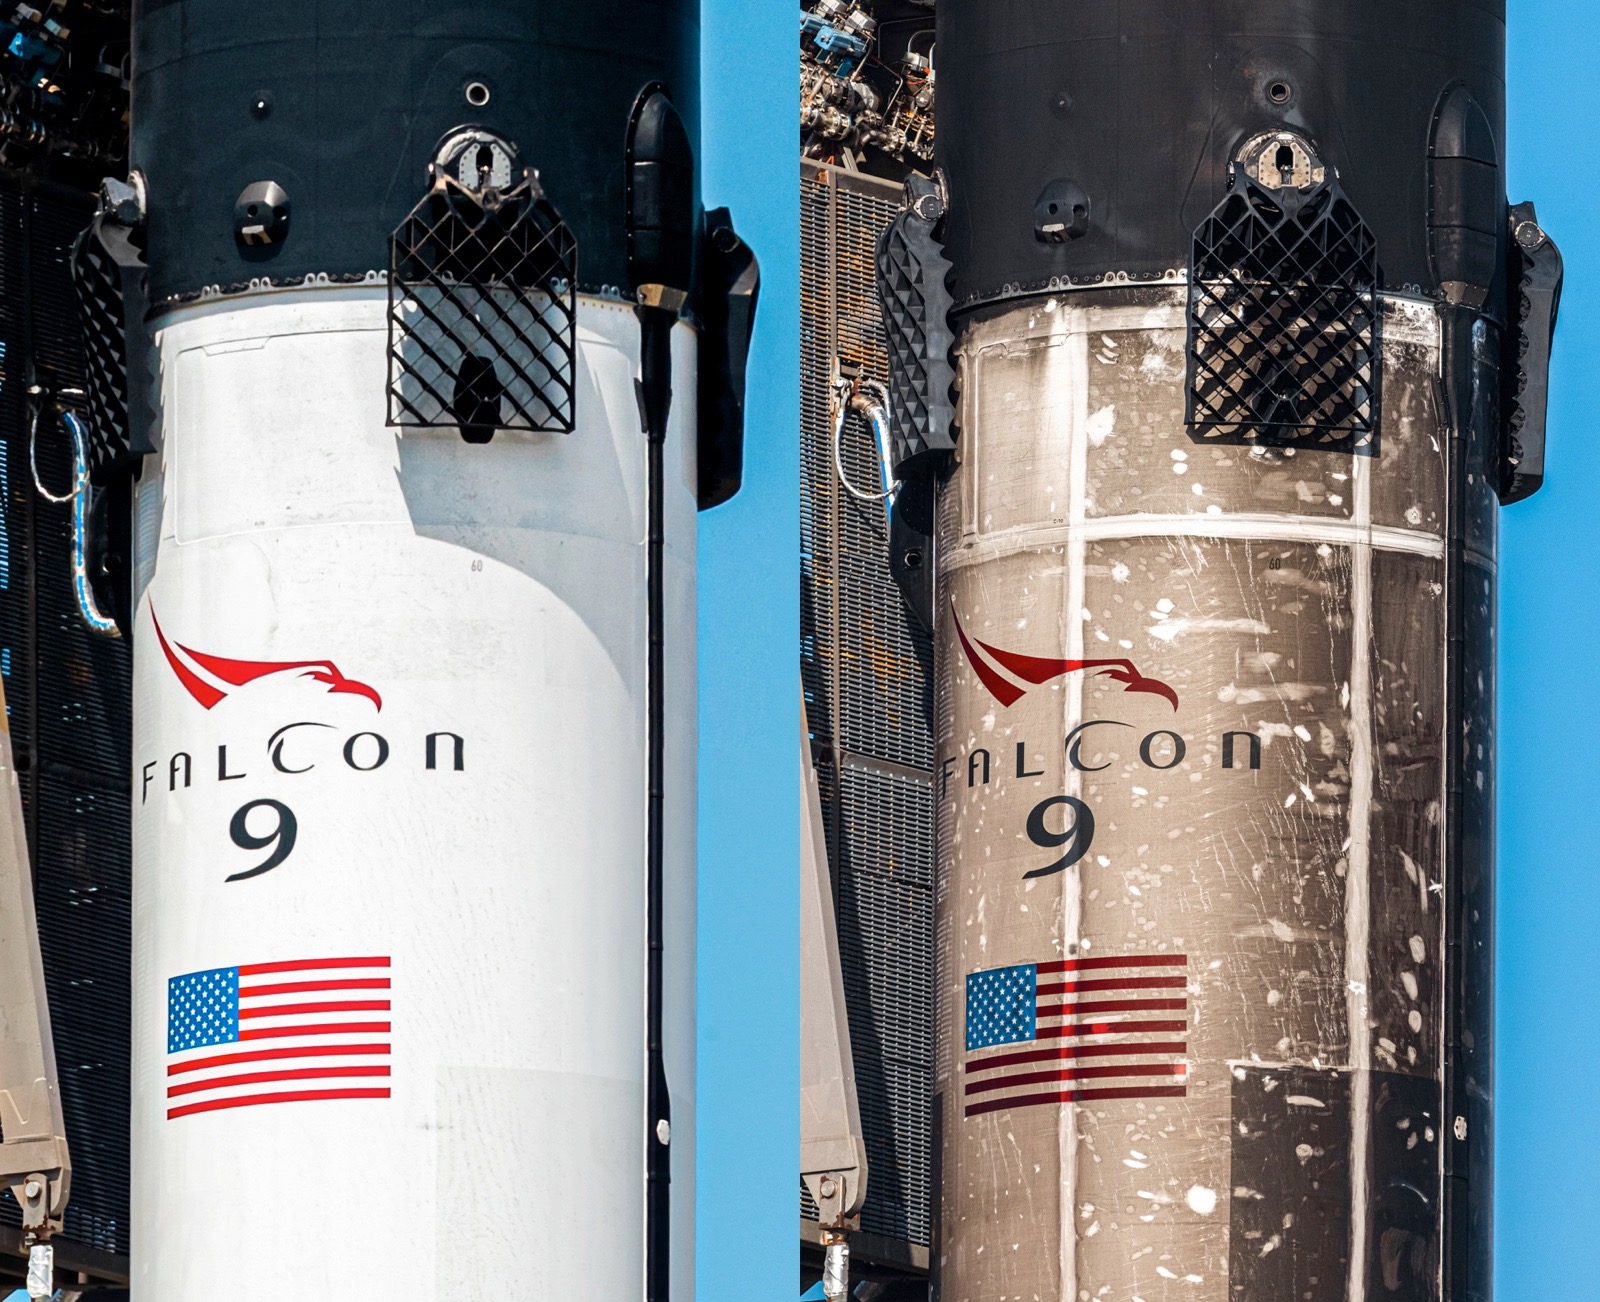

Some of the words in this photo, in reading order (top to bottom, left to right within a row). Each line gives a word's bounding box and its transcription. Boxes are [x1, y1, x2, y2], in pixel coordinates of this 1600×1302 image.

[471, 559, 483, 572] 60
[1269, 558, 1281, 570] 60
[225, 798, 298, 883] 9
[1022, 795, 1095, 880] 9
